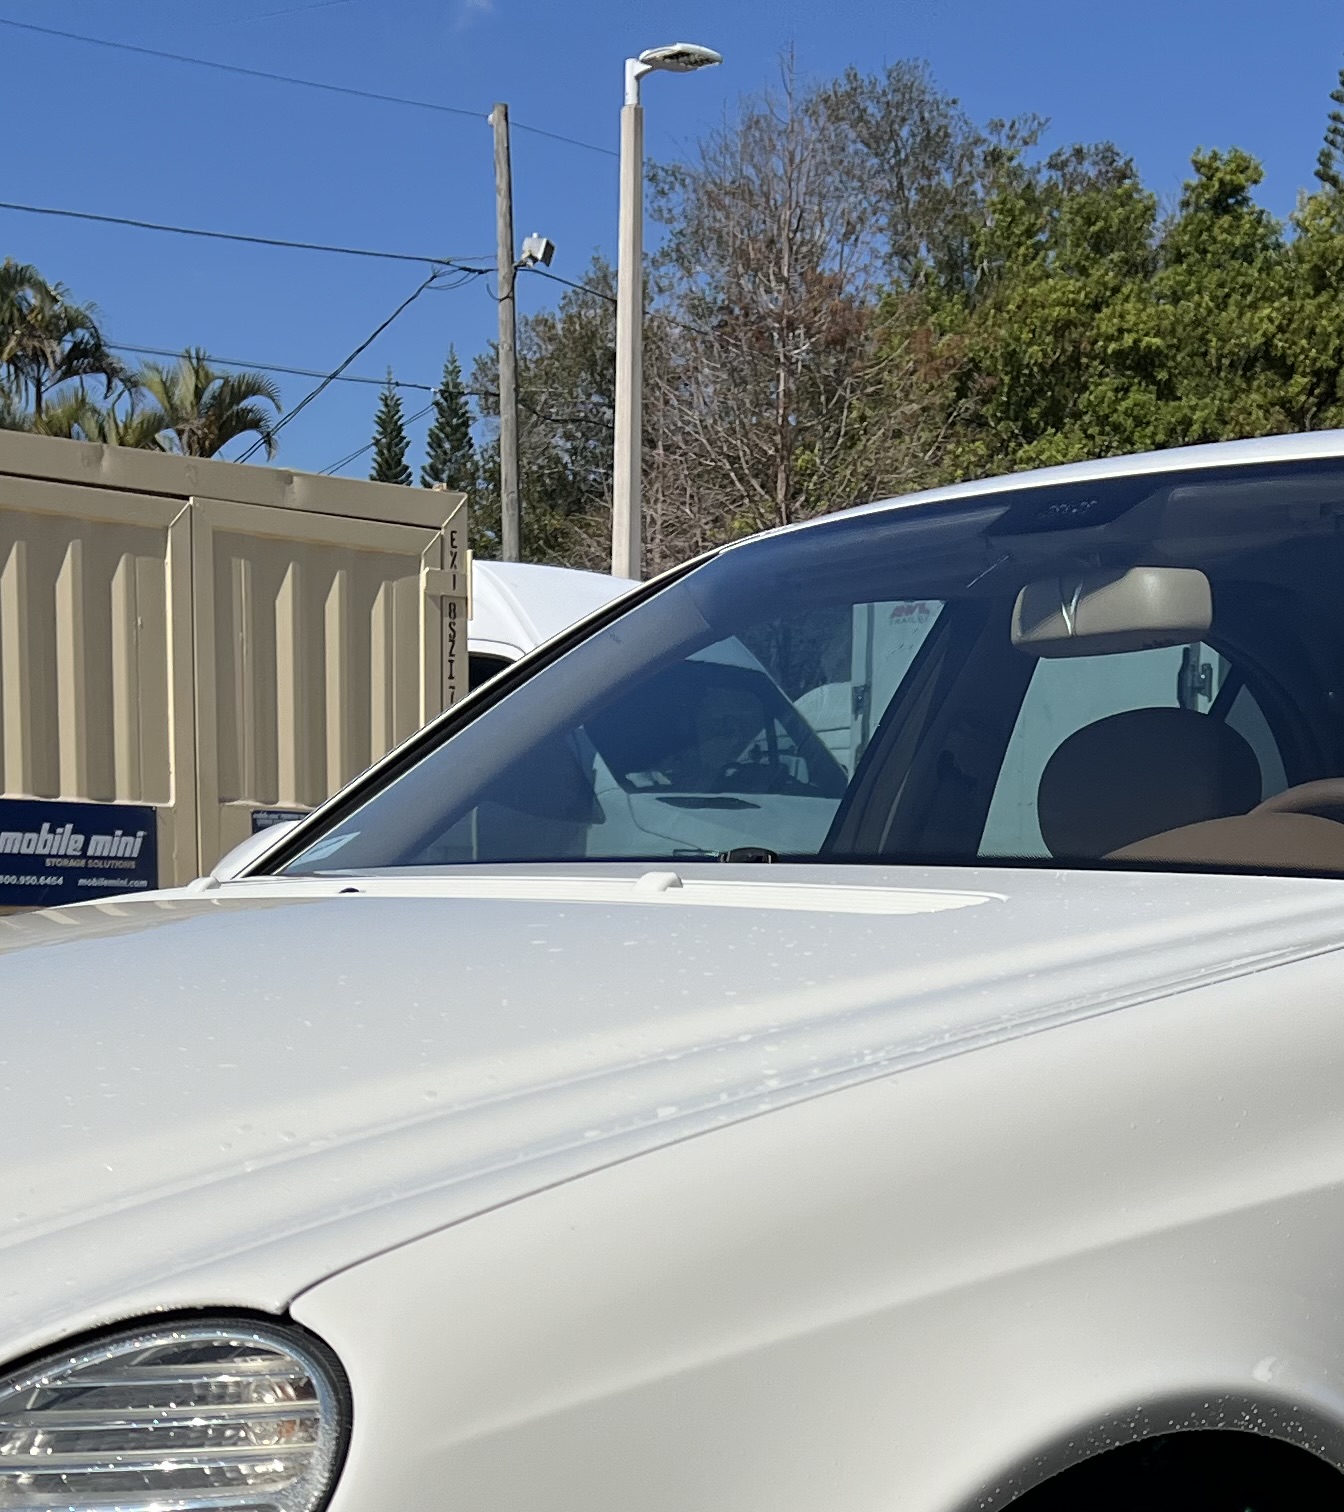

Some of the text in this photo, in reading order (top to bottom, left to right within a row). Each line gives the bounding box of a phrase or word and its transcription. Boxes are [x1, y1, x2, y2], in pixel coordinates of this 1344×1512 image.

[86, 829, 146, 858] mini
[45, 858, 136, 869] STORAGE SOLUTIONS
[77, 878, 148, 888] mobilemini.com
